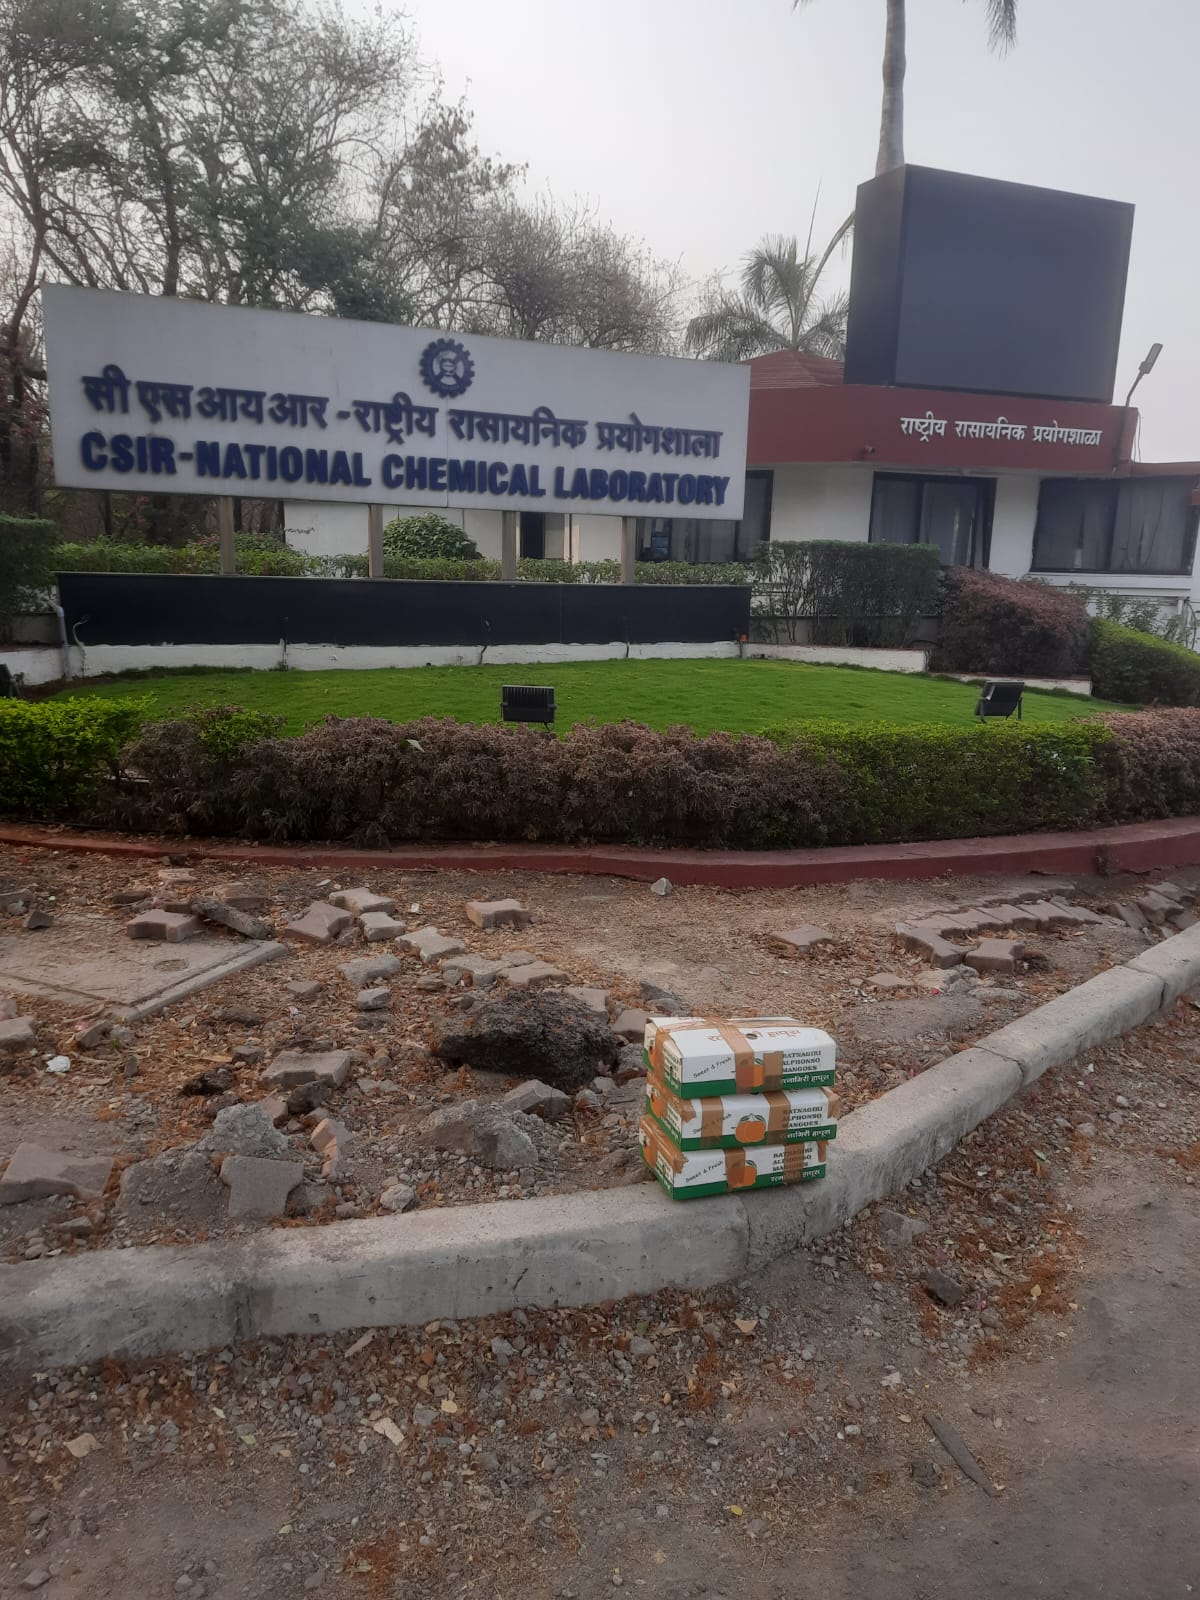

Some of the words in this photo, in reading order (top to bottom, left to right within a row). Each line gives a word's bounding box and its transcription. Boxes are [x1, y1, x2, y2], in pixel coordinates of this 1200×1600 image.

[448, 405, 588, 449] रासायनिक
[596, 412, 723, 458] प्रयोगशाला
[900, 411, 948, 442] राष्ट्रीय
[955, 416, 1027, 440] रासायनिक
[381, 453, 546, 496] CHEMICAL
[554, 466, 730, 506] LABORATORY
